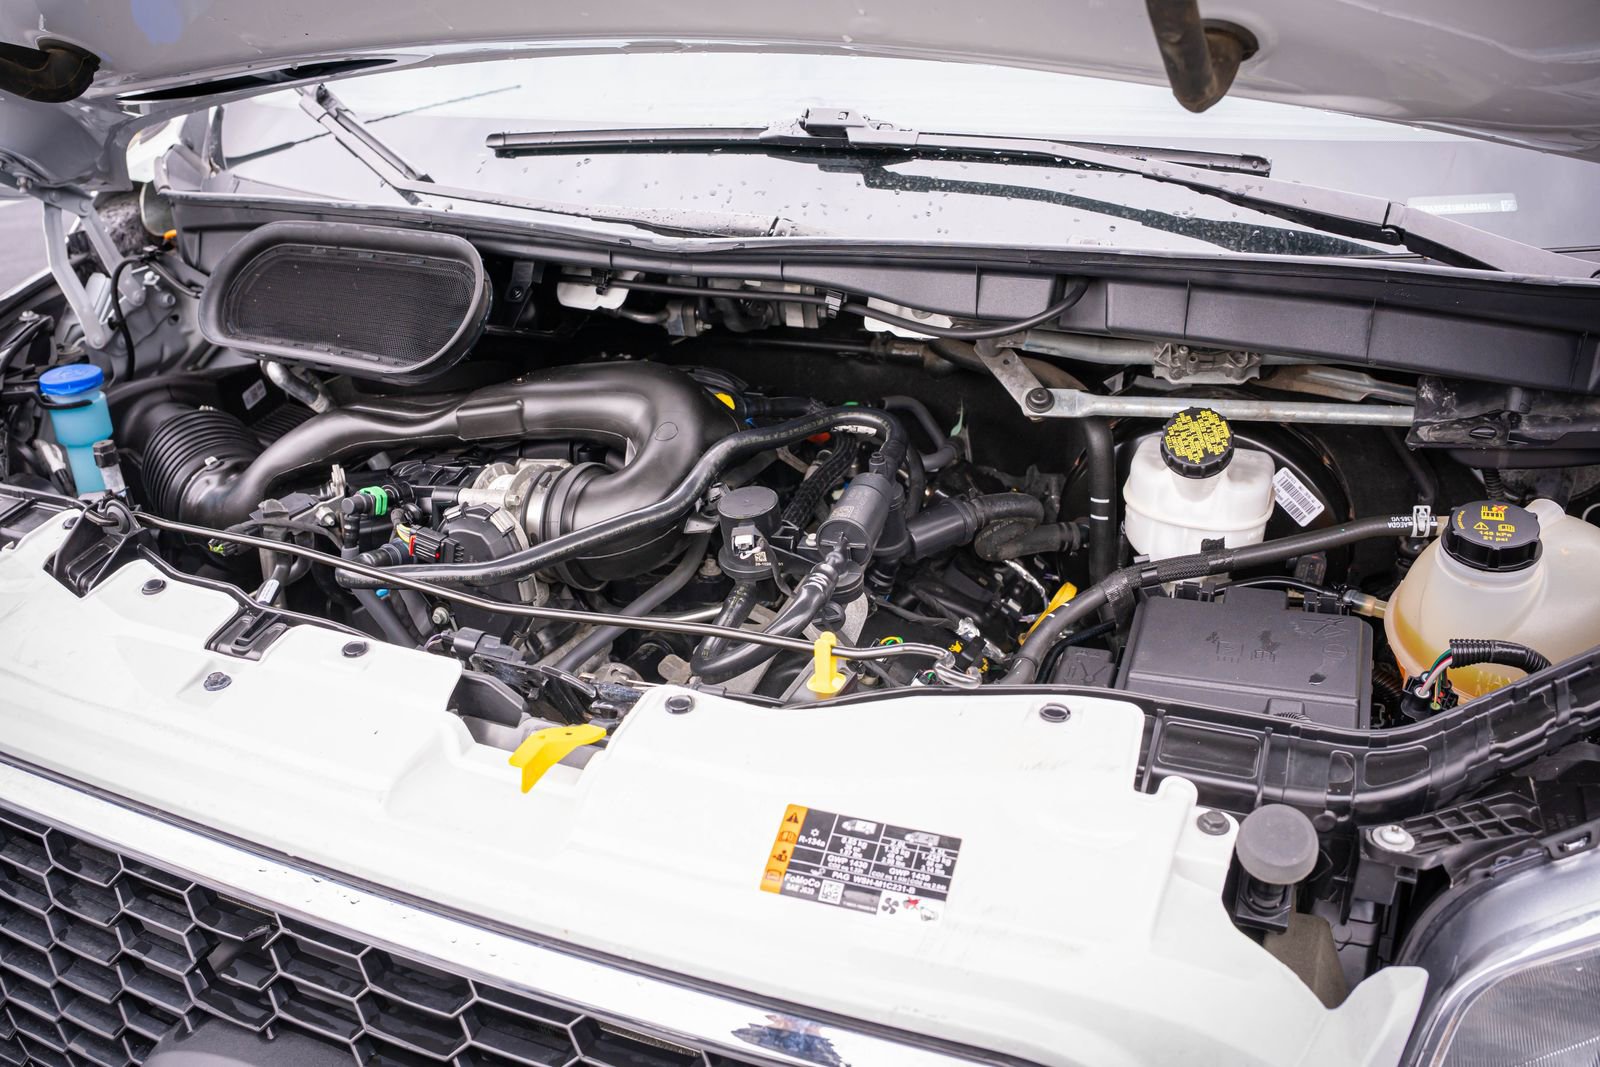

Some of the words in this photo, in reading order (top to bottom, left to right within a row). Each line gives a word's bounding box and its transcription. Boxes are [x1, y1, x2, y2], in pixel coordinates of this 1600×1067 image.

[798, 834, 826, 848] R-134a
[858, 840, 868, 850] kg
[900, 848, 910, 858] kg
[827, 854, 848, 864] GWP
[850, 860, 868, 870] 1430
[940, 857, 952, 867] kg
[784, 872, 820, 888] FoMoCo
[832, 870, 850, 881] PAG
[888, 867, 910, 877] GWP
[911, 872, 931, 882] 1430
